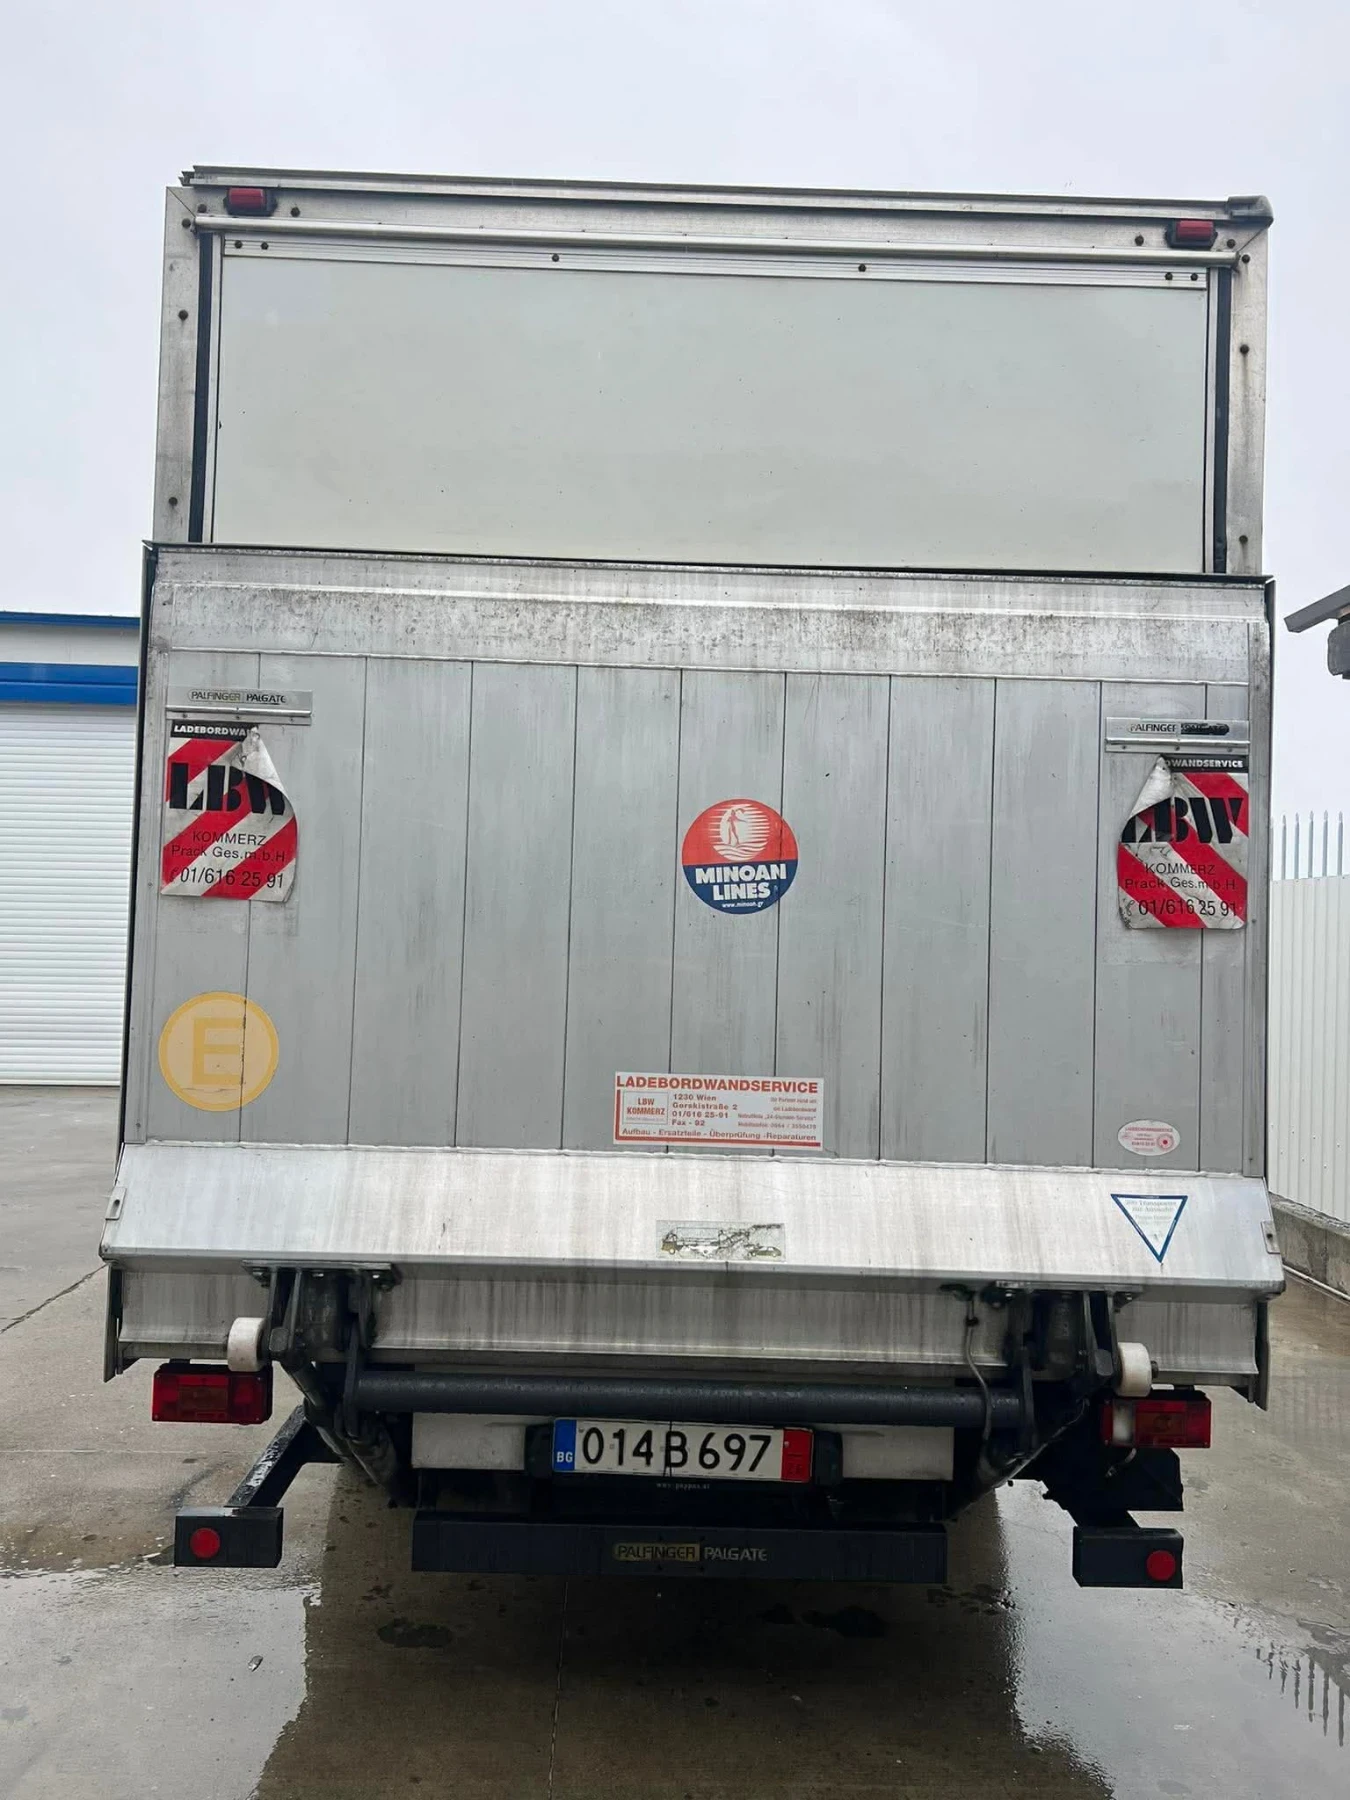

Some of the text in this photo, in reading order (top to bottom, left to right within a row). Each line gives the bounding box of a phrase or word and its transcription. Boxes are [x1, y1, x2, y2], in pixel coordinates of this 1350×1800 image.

[191, 691, 286, 704] PALFINGER PALGATE
[192, 830, 266, 847] KOMMERZ
[171, 844, 207, 857] Prack
[695, 863, 787, 885] MINOAN
[1145, 863, 1216, 875] KOMMERZ
[180, 867, 284, 889] 01/616 25 91
[1125, 878, 1165, 890] Prack
[713, 882, 771, 901] LINES
[1138, 898, 1237, 917] 01/616 25 91
[192, 1017, 245, 1085] E
[616, 1075, 819, 1094] LADEBORDWANDSERVICE
[637, 1097, 655, 1106] LBW
[673, 1093, 694, 1101] 1230
[626, 1106, 666, 1116] KOMMERZ
[621, 1127, 651, 1136] Aufbau
[658, 1128, 702, 1137] Ersatzteile
[709, 1128, 761, 1139] Überprüfung
[556, 1451, 574, 1463] BG
[618, 1544, 768, 1562] PALFINGER PALGATE
